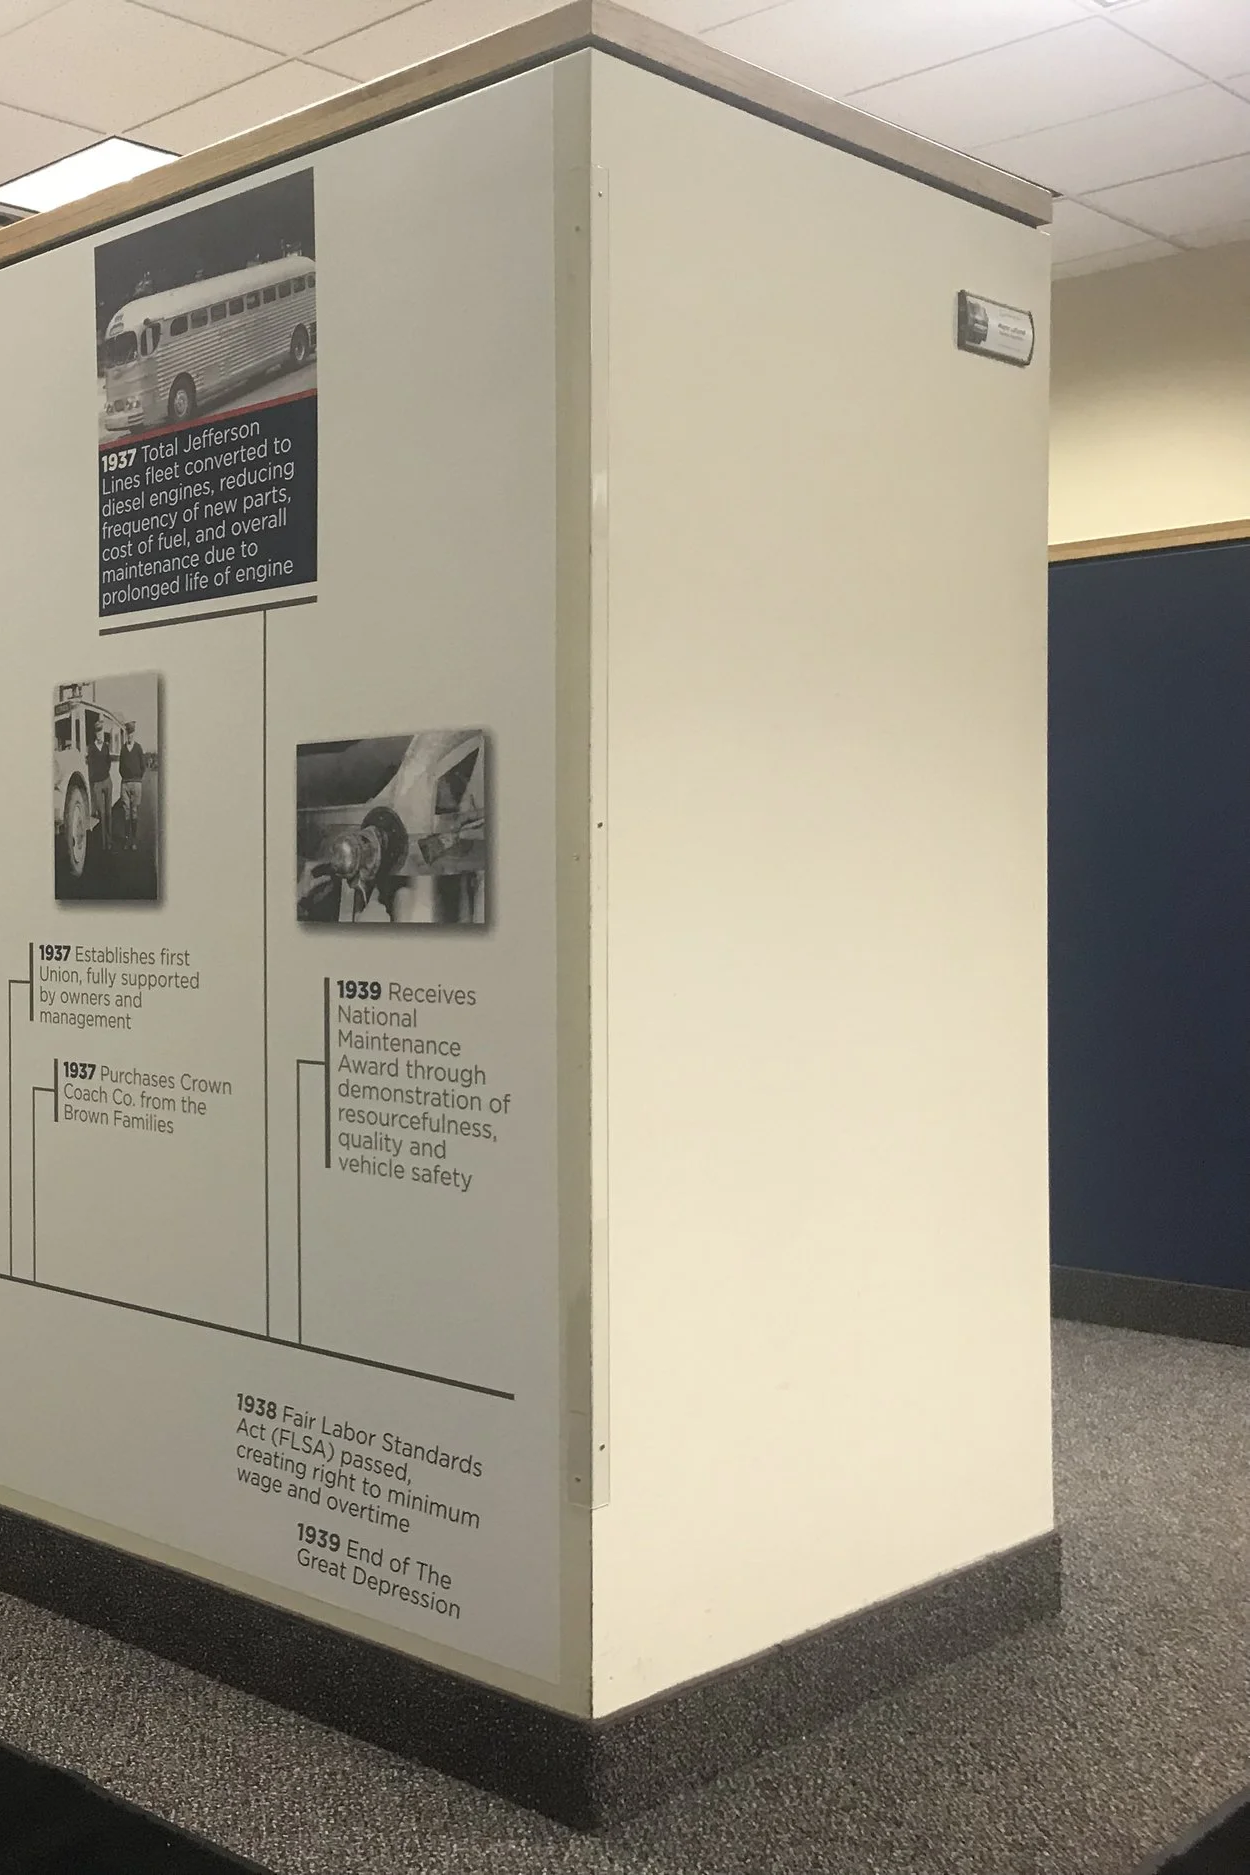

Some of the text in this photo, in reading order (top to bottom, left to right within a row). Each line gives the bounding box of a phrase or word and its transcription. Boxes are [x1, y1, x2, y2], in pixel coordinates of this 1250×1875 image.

[102, 421, 260, 472] 1937 Total Jefferson
[103, 437, 291, 495] Lines fleet converted to
[102, 461, 294, 516] diesel engines, reducing
[103, 487, 291, 539] frequency of new parts,
[39, 945, 190, 966] 1937 Establishes first
[40, 966, 199, 990] Union, fully supported
[337, 980, 476, 1005] 1939 Receives
[40, 986, 142, 1008] by owners and
[40, 1011, 131, 1029] management
[338, 1005, 417, 1027] National
[339, 1029, 461, 1057] Maintenance
[338, 1054, 486, 1088] Award through
[338, 1079, 510, 1114] demonstration of
[339, 1107, 496, 1142] resourcefulness,
[339, 1131, 445, 1159] quality and
[339, 1155, 472, 1192] vehicle safety
[237, 1393, 482, 1477] 1938 Fair Labor Standards
[237, 1417, 412, 1485] Act (FLSA) passed,
[237, 1444, 480, 1529] creating right to minimum
[237, 1467, 410, 1533] wage and overtime
